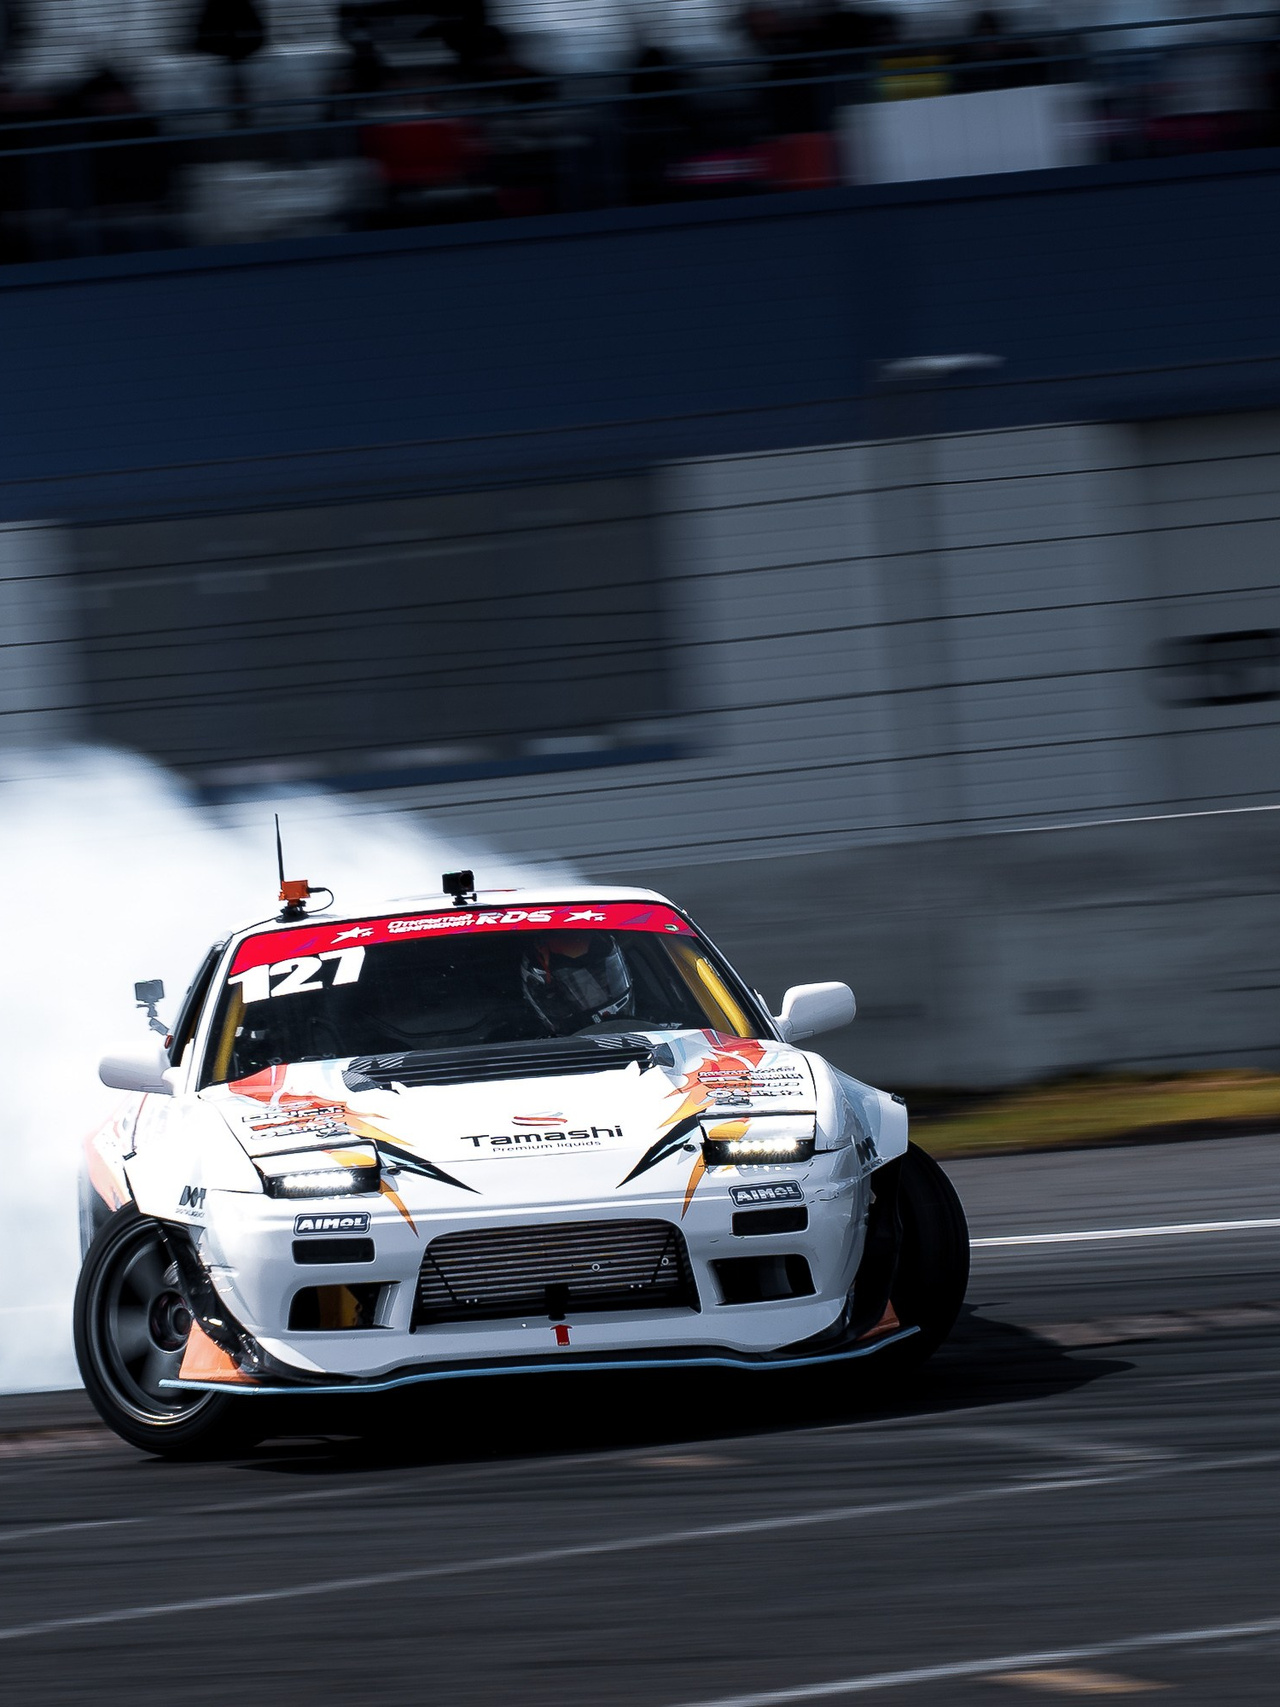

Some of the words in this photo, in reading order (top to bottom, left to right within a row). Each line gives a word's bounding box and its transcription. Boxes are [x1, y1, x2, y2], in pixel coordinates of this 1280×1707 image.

[475, 910, 555, 925] RDS
[228, 946, 365, 1004] 127
[460, 1126, 623, 1147] Tamashi
[493, 1143, 553, 1152] Premium
[557, 1140, 602, 1148] liquids
[737, 1186, 795, 1202] AIMOL
[297, 1217, 365, 1231] AIMOL
